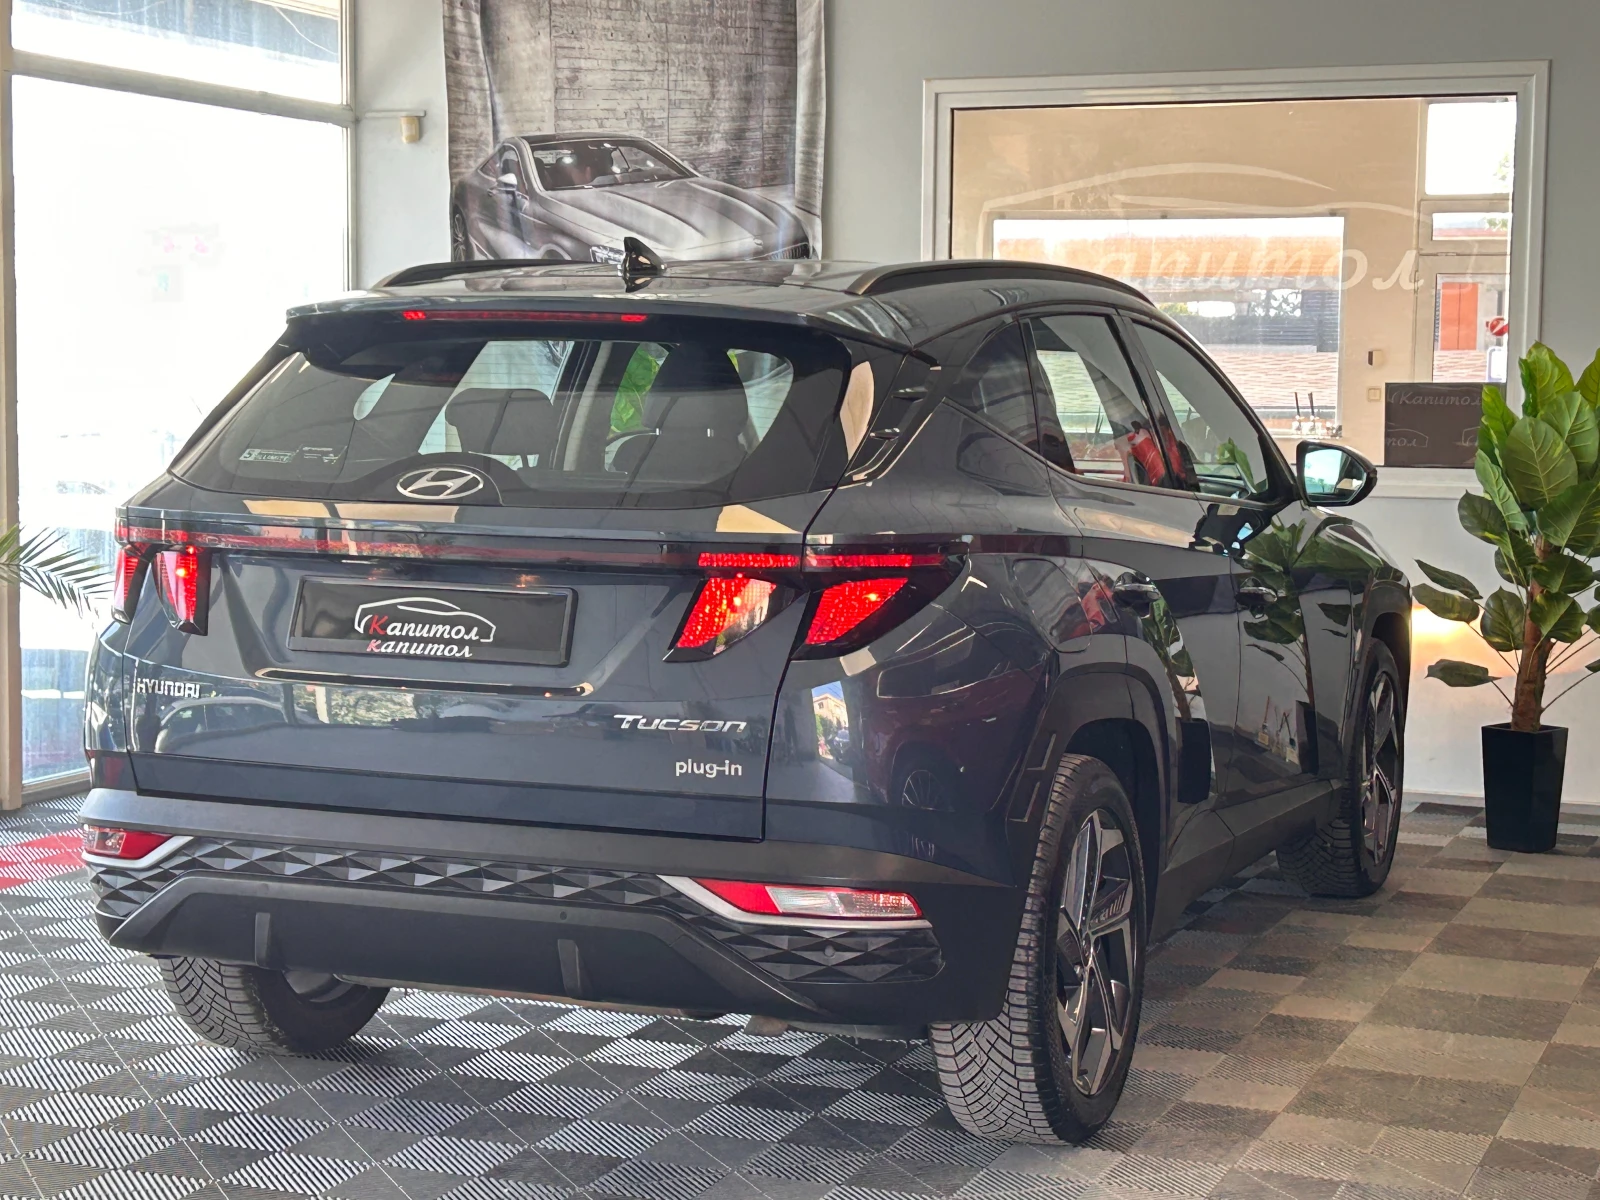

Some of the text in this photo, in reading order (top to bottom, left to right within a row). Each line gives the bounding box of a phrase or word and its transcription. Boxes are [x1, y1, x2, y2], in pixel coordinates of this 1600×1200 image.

[369, 614, 480, 641] Капитол
[136, 677, 200, 699] HYUNDAI
[675, 758, 743, 778] plug-in
